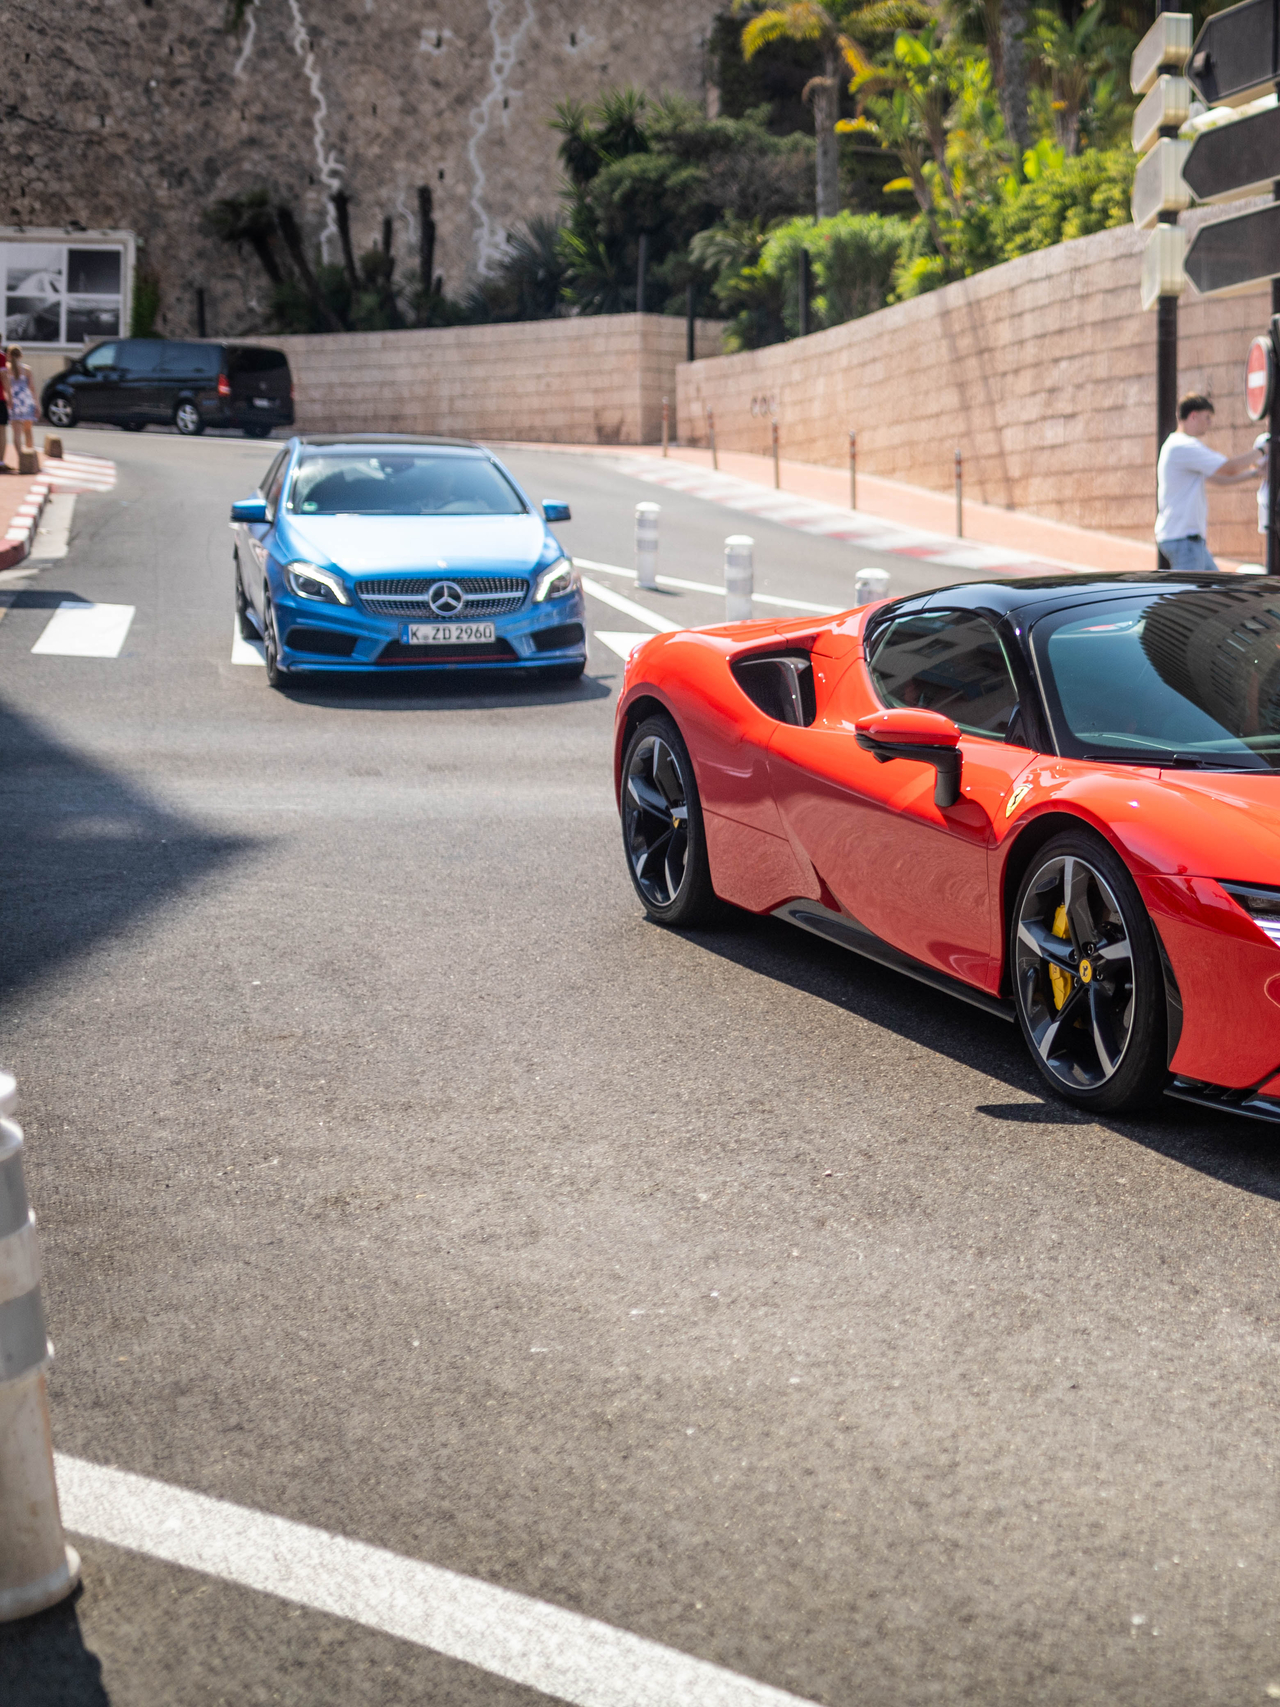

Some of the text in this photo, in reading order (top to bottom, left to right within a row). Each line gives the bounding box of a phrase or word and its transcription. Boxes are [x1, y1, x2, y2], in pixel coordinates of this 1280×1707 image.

[410, 625, 492, 641] K ZD 2960
